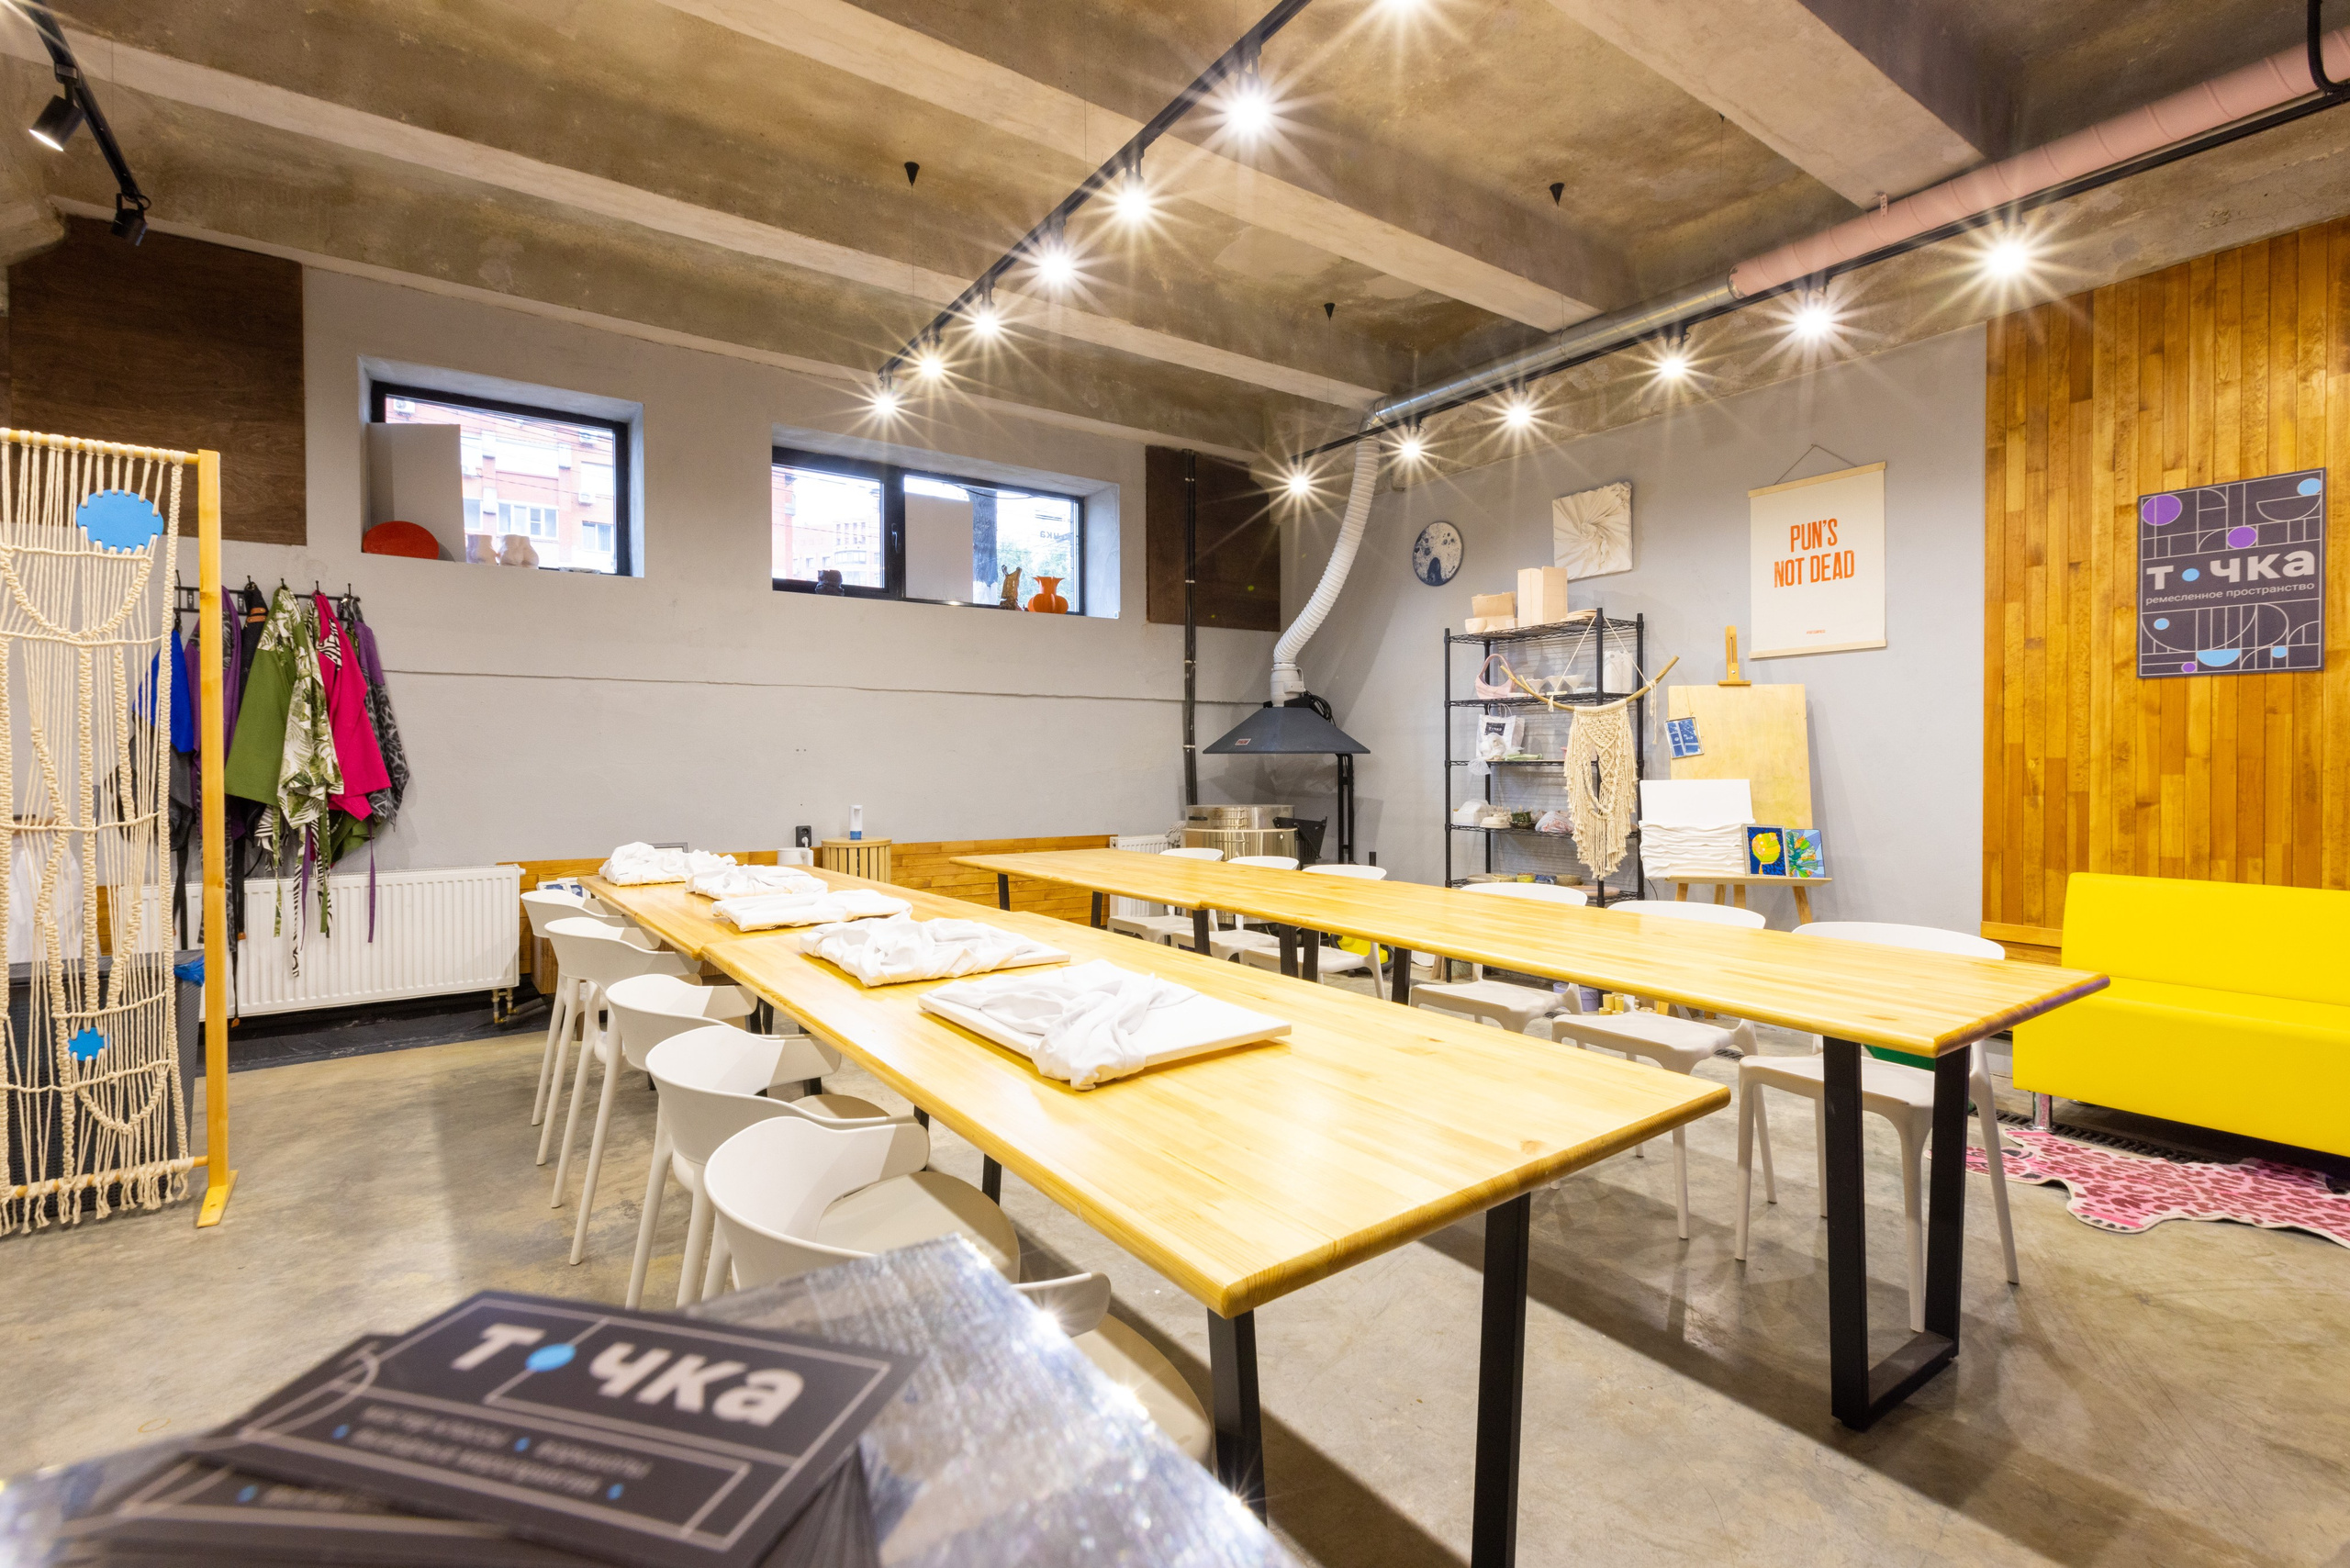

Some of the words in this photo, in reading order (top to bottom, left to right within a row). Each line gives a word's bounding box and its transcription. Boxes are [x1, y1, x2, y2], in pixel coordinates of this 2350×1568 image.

[1790, 518, 1838, 553] PUN'S
[1774, 557, 1805, 588] NOT
[1810, 550, 1855, 583] DEAD
[2145, 590, 2223, 606] ремесленное
[2225, 582, 2315, 599] пространство
